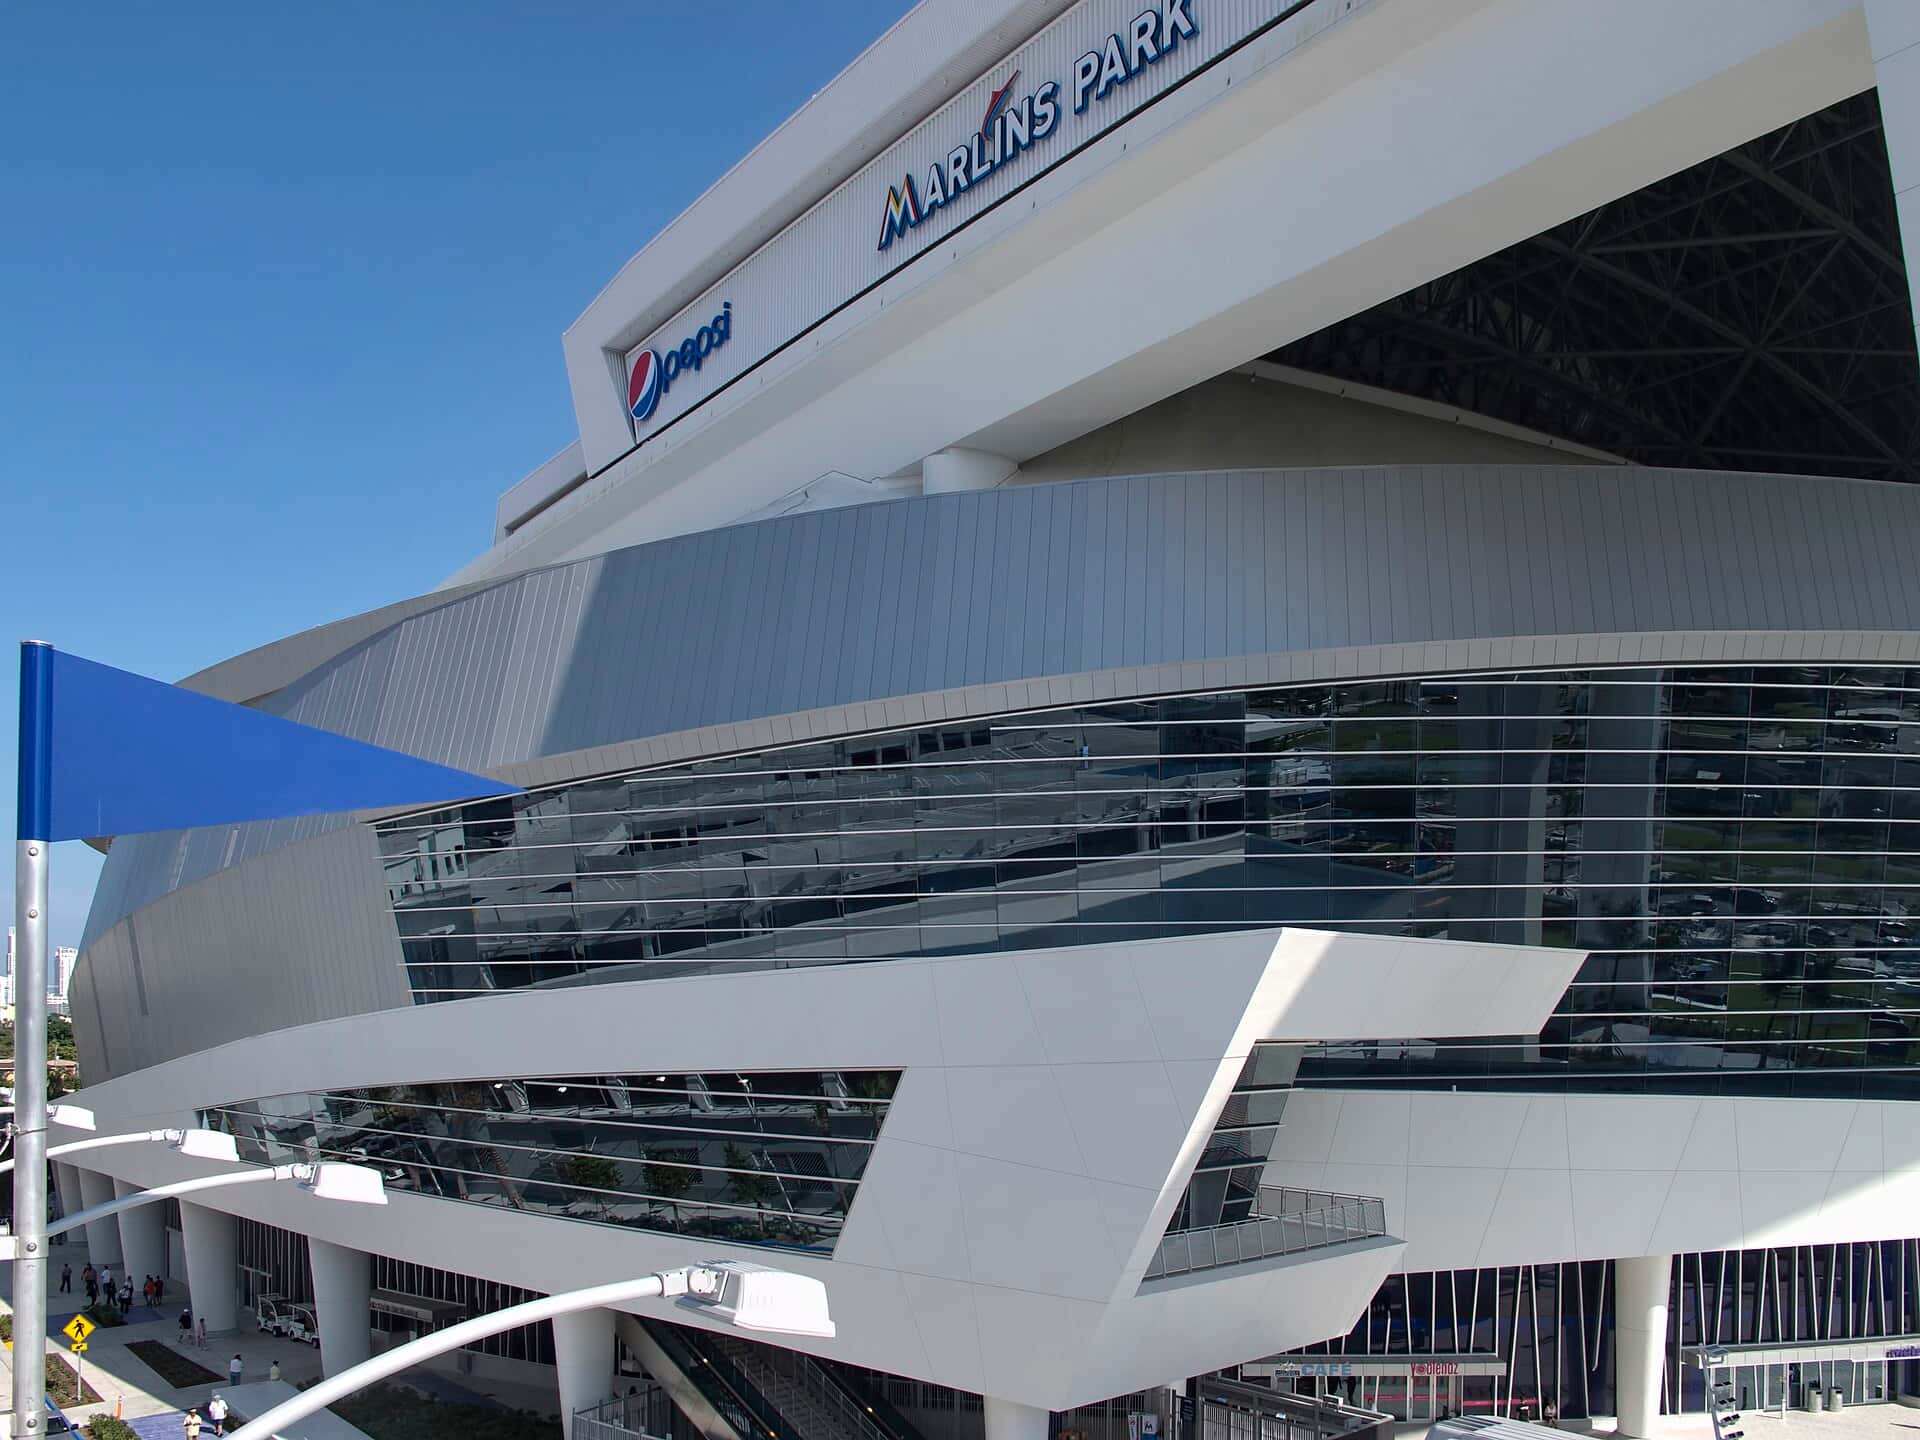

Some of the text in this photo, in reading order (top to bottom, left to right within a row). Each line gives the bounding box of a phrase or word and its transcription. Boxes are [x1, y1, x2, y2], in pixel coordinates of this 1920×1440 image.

[878, 0, 1200, 250] MARLINS PARK
[662, 301, 731, 393] pepsi
